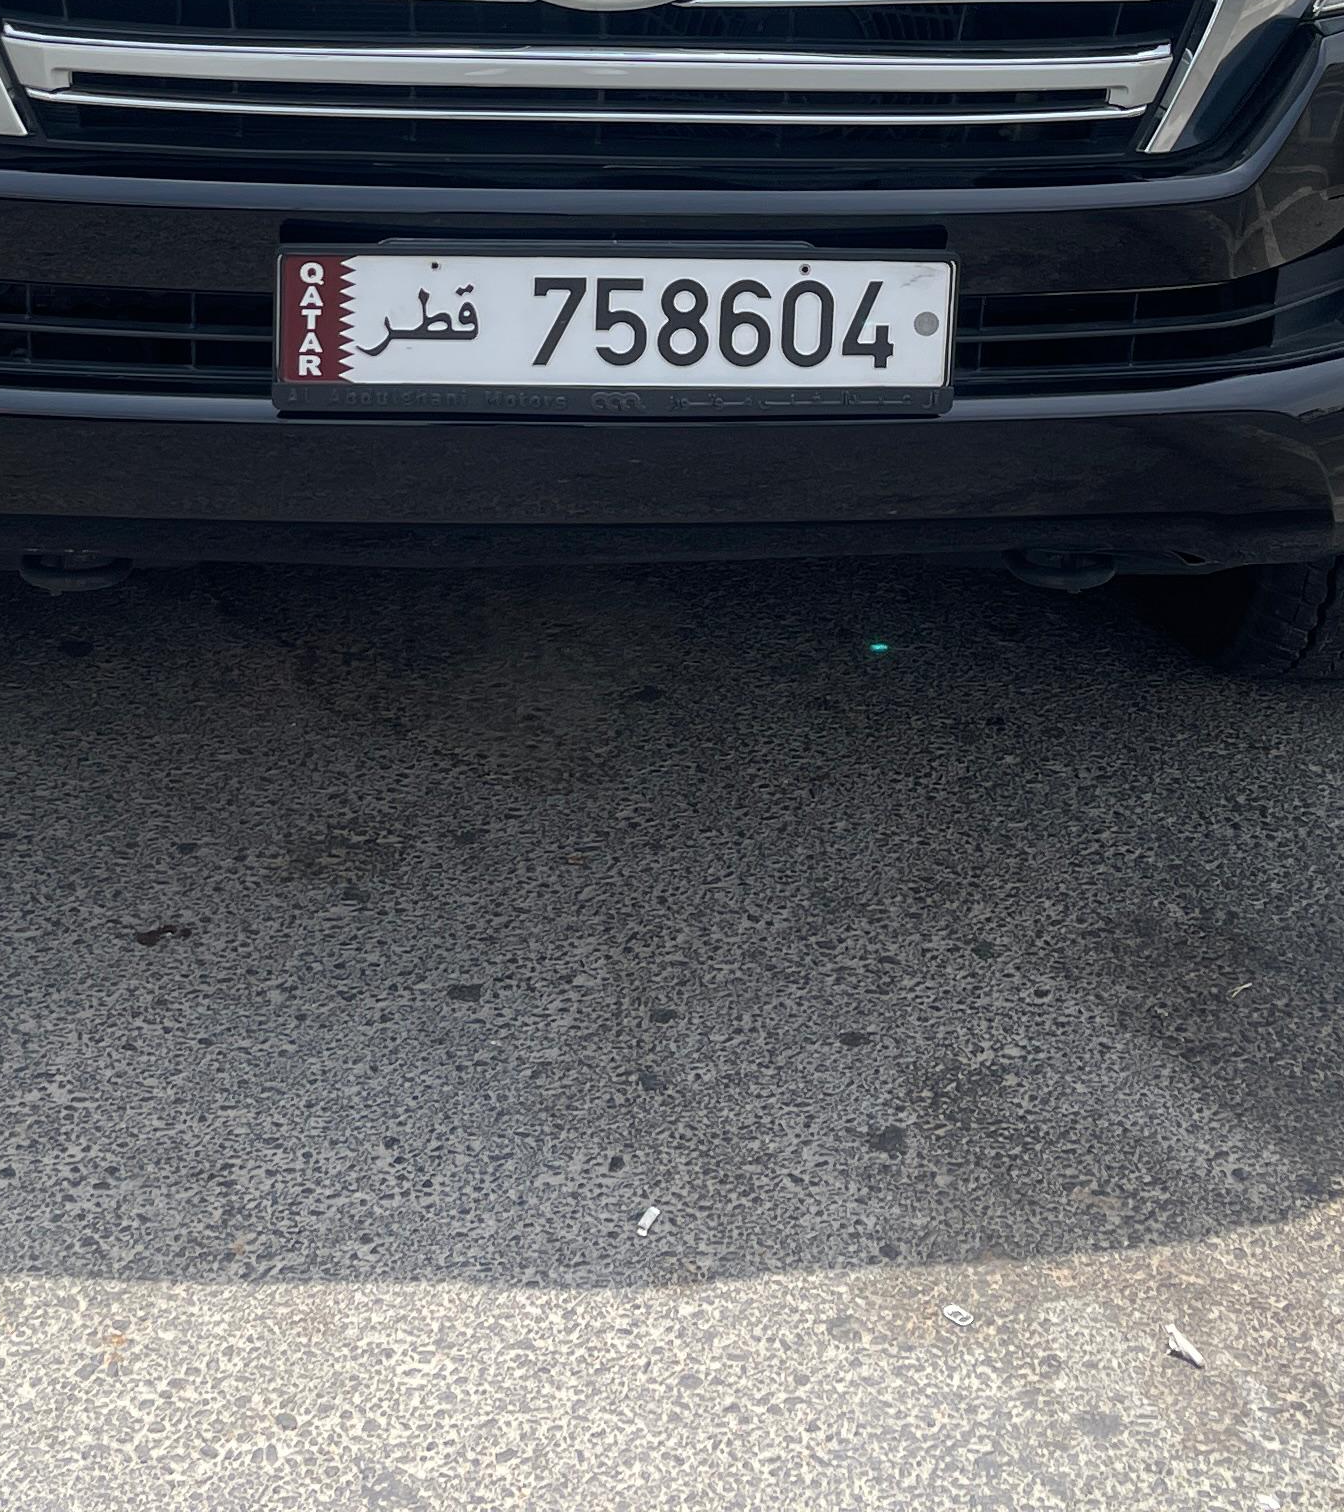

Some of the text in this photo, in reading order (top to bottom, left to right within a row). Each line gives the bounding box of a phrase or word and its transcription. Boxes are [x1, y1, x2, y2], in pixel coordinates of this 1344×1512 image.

[298, 261, 324, 376] QATAR
[356, 284, 479, 357] قطر
[532, 277, 894, 369] 758604
[327, 389, 470, 409] Abdulghani
[484, 390, 569, 410] Motors
